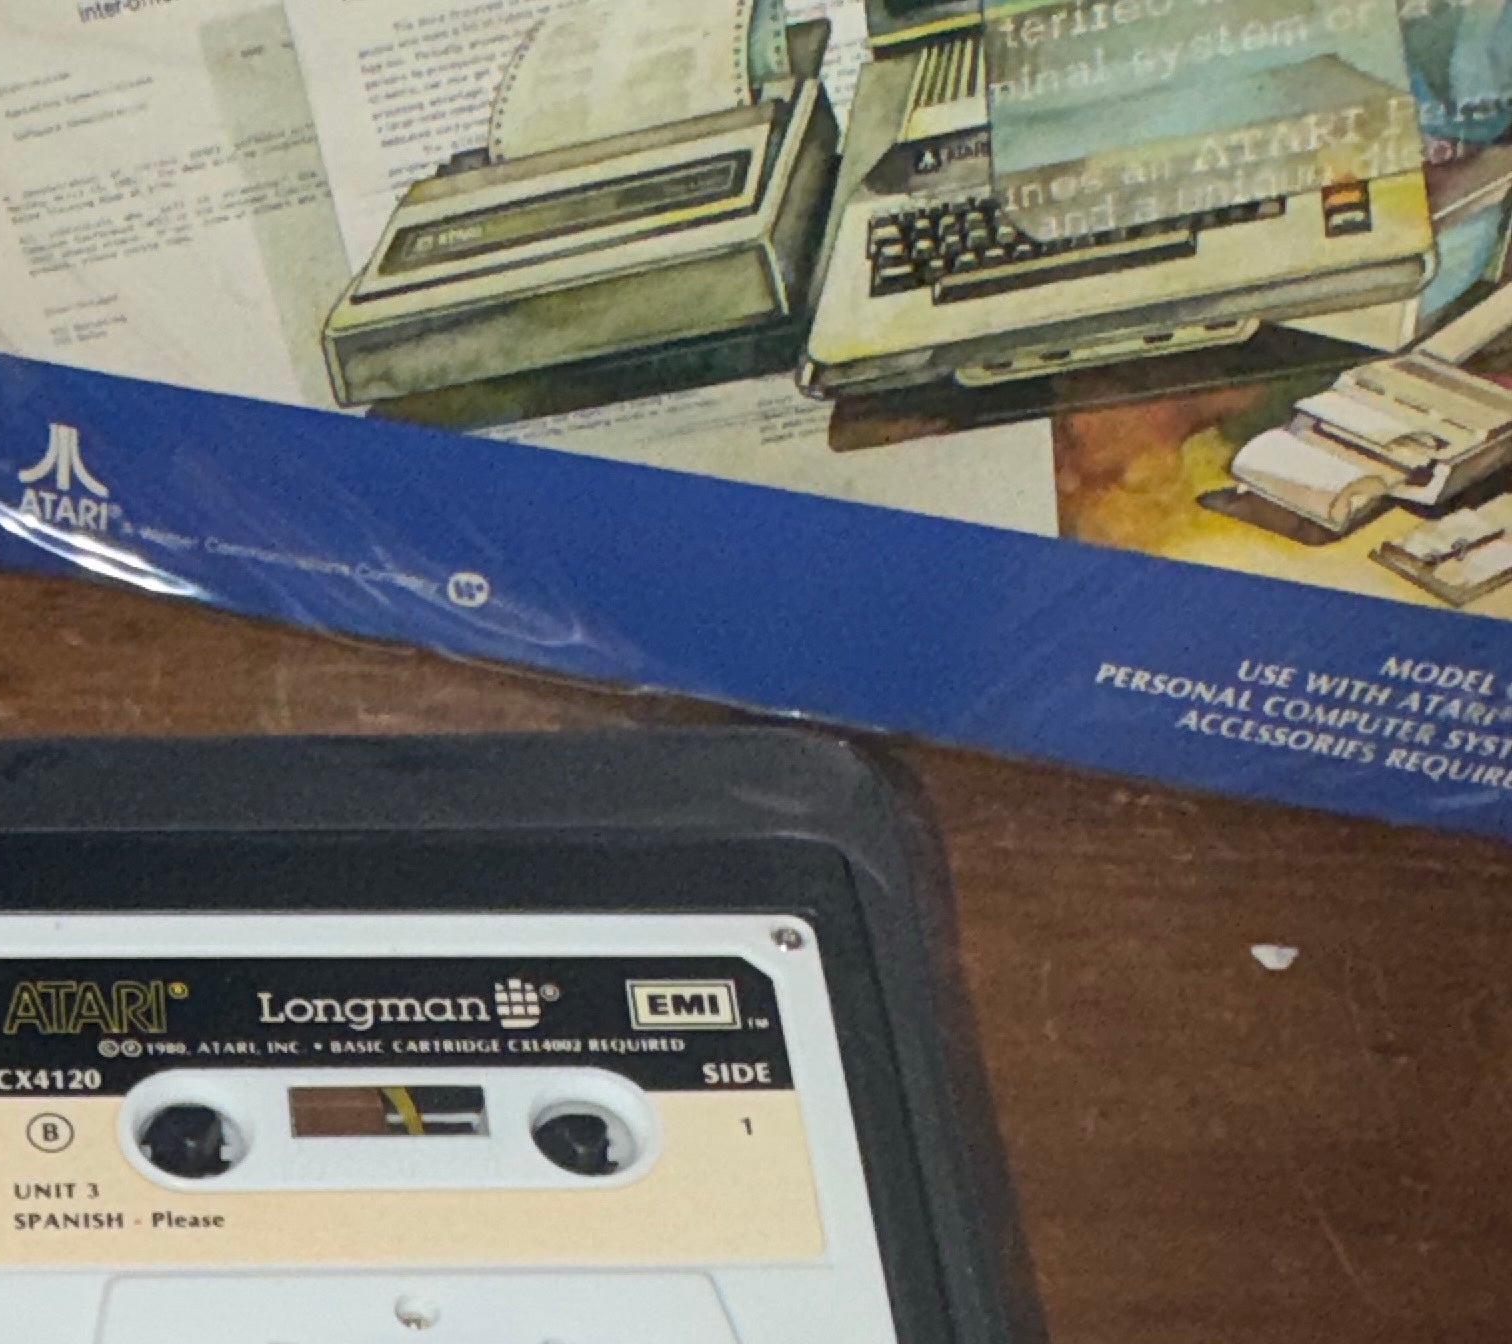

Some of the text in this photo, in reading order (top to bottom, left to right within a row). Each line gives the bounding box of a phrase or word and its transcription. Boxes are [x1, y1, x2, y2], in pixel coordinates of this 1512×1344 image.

[1238, 660, 1296, 689] USE
[1306, 672, 1391, 707] WITH
[1379, 655, 1494, 696] MODEL
[1095, 662, 1251, 712] PERSONAL
[1263, 696, 1438, 746] COMPUTER
[1175, 710, 1377, 764] ACCESSORIES
[257, 992, 491, 1031] Longman
[647, 995, 719, 1015] EMI
[331, 1041, 383, 1053] BASIC
[393, 1039, 500, 1053] CARTRIDGE
[589, 1039, 685, 1053] REQUIRED
[703, 1063, 771, 1083] SIDE
[741, 1117, 752, 1135] 1
[15, 1183, 99, 1199] UNIT 3
[15, 1213, 123, 1229] SPANISH
[152, 1211, 225, 1227] Please
